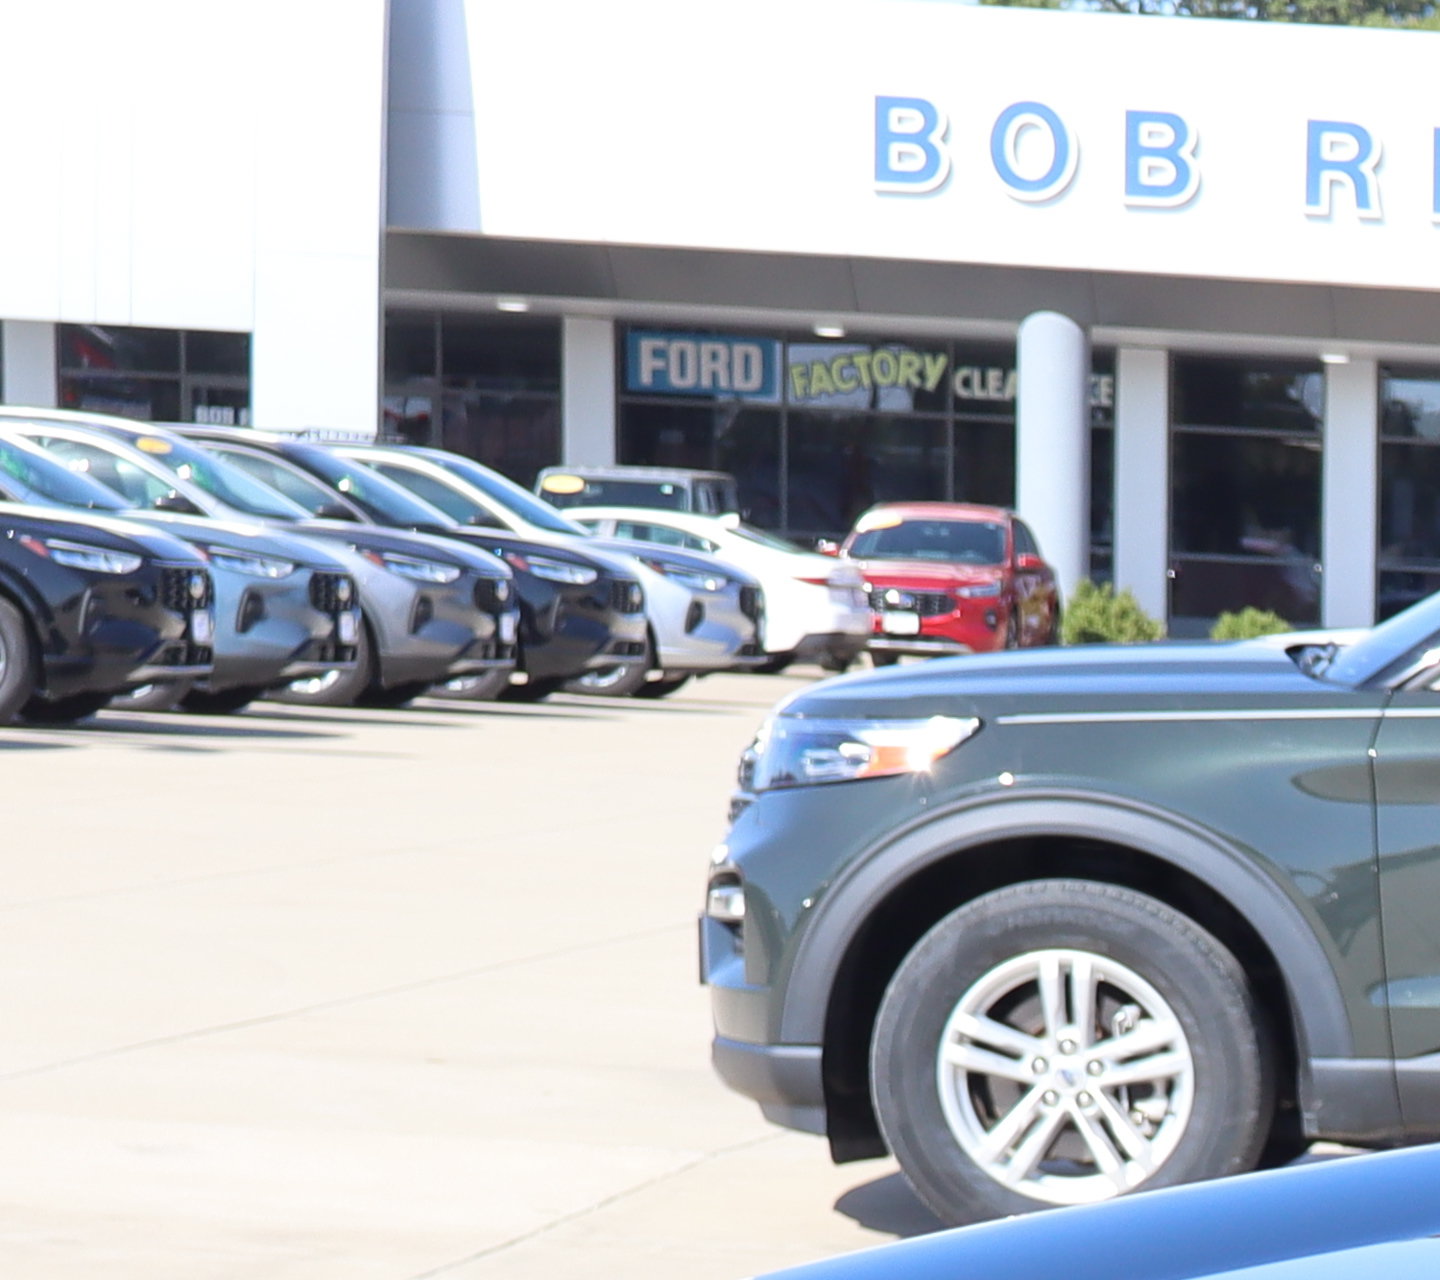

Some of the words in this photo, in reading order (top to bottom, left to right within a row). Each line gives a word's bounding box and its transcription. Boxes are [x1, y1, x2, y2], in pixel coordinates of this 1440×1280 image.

[873, 95, 1200, 209] BOB
[639, 338, 764, 392] FORD
[791, 351, 948, 399] FACTORY
